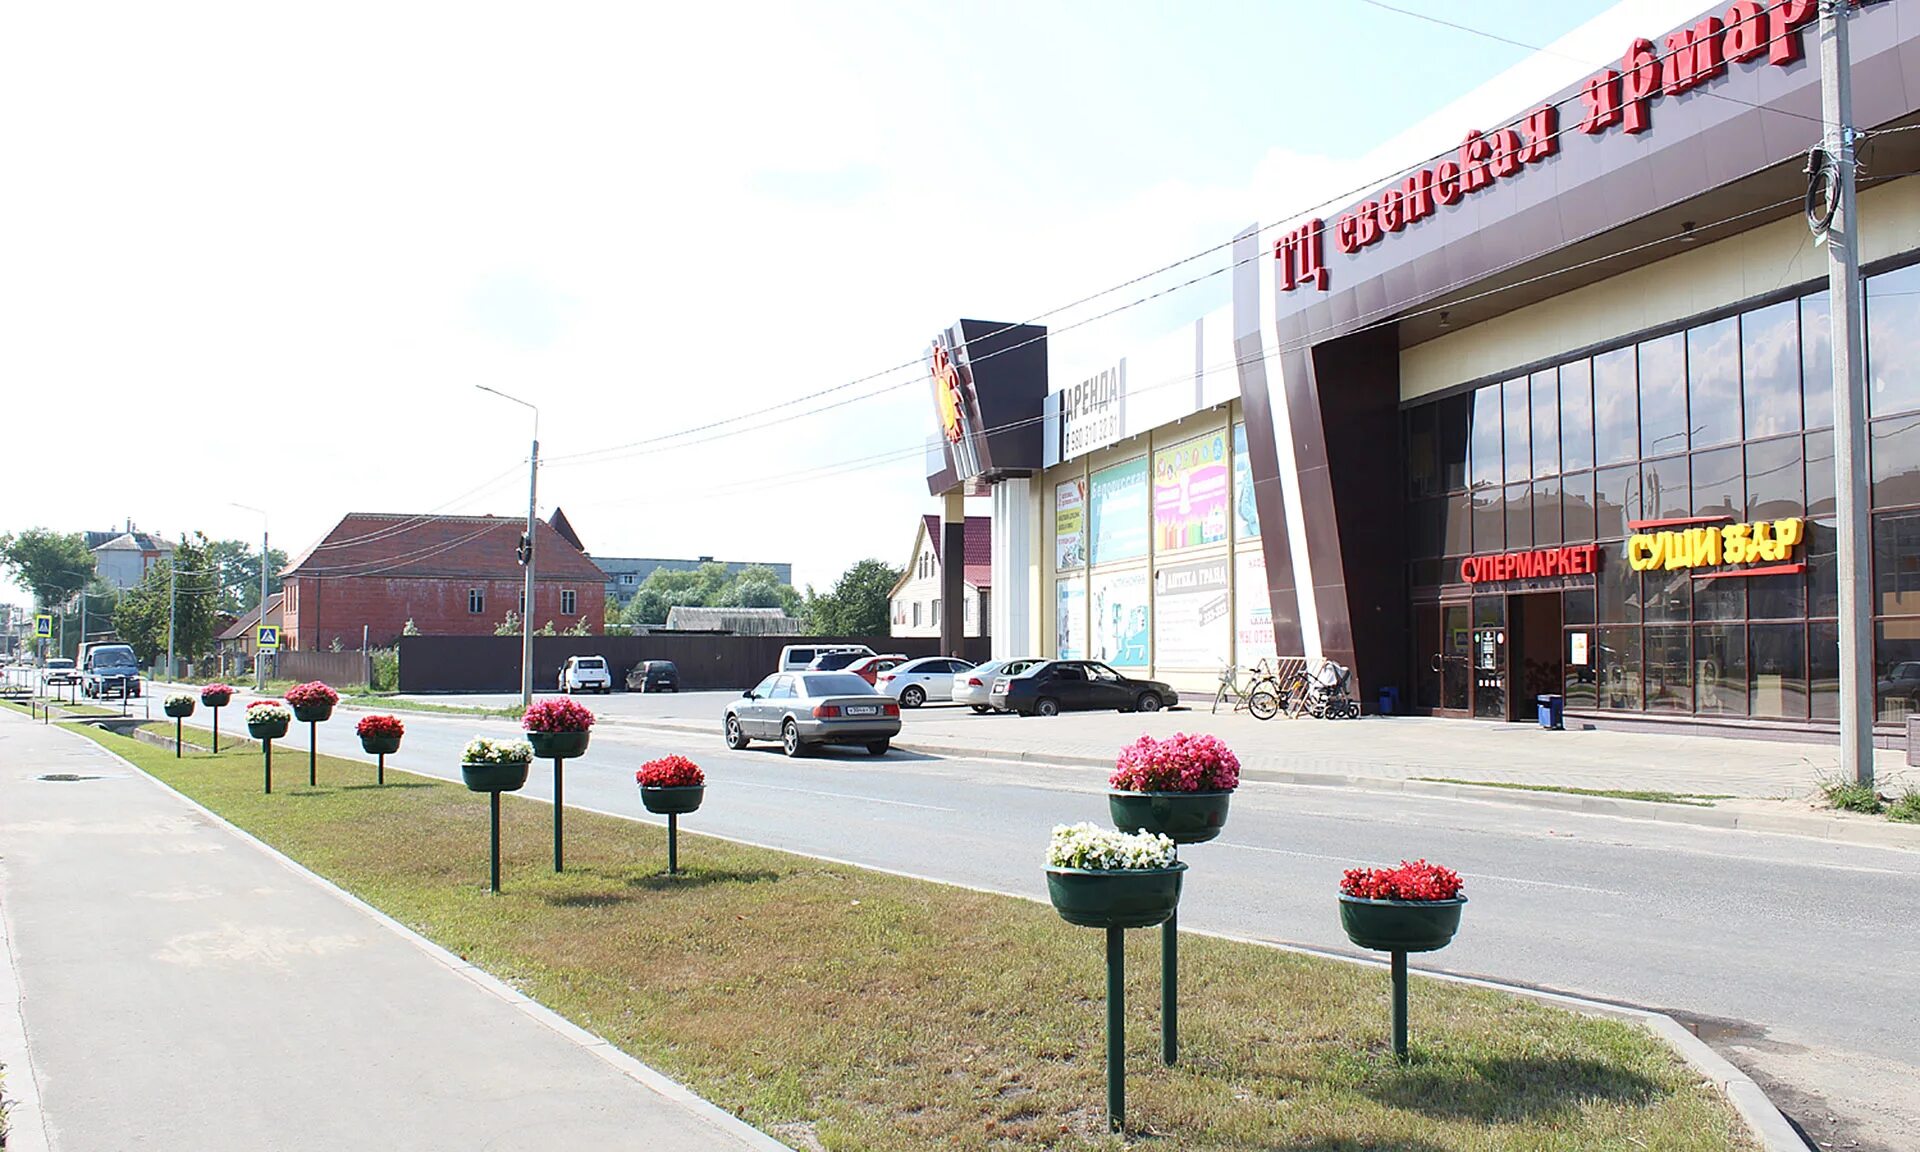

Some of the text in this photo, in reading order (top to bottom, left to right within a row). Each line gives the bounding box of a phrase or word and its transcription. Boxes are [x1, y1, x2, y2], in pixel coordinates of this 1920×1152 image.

[1273, 218, 1328, 291] ТЦ
[1065, 366, 1118, 423] АРЕНДА
[1461, 543, 1599, 583] СУПЕРМАРКЕТ
[1628, 526, 1722, 571] СУШИ
